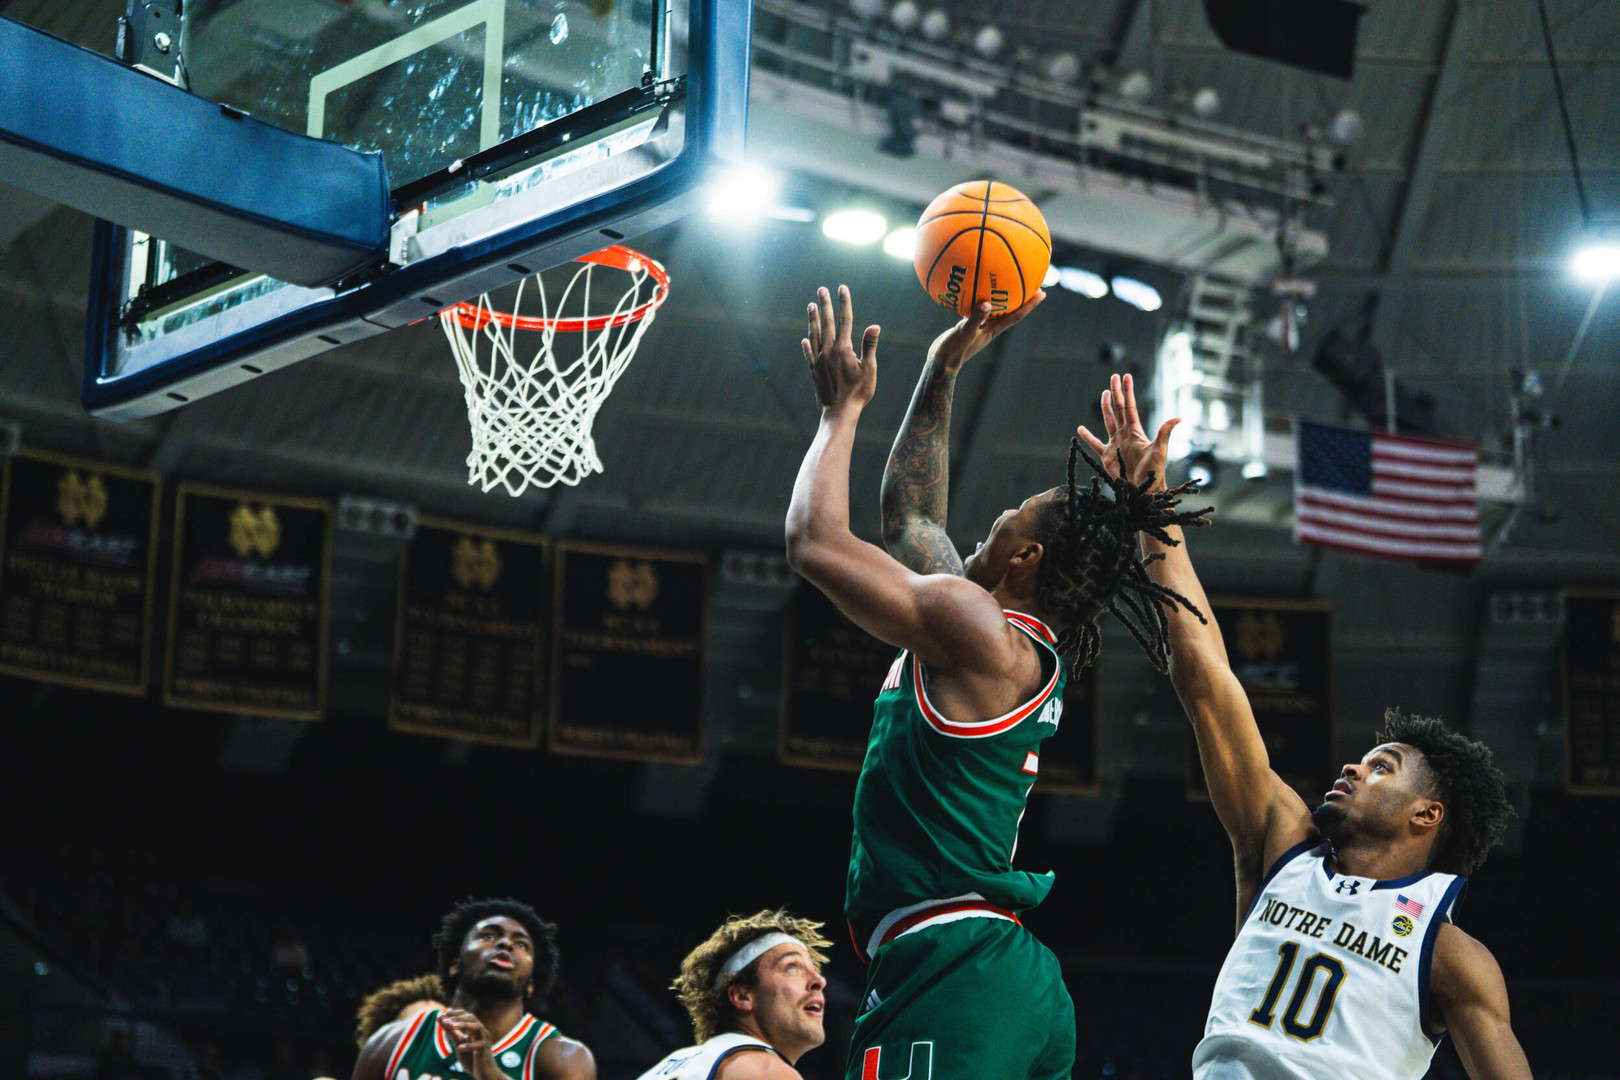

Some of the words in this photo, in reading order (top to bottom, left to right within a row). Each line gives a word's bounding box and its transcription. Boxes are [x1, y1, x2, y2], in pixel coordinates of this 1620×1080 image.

[1258, 898, 1332, 939] NOTRE
[1332, 921, 1409, 975] DAME
[1247, 940, 1348, 1043] 10
